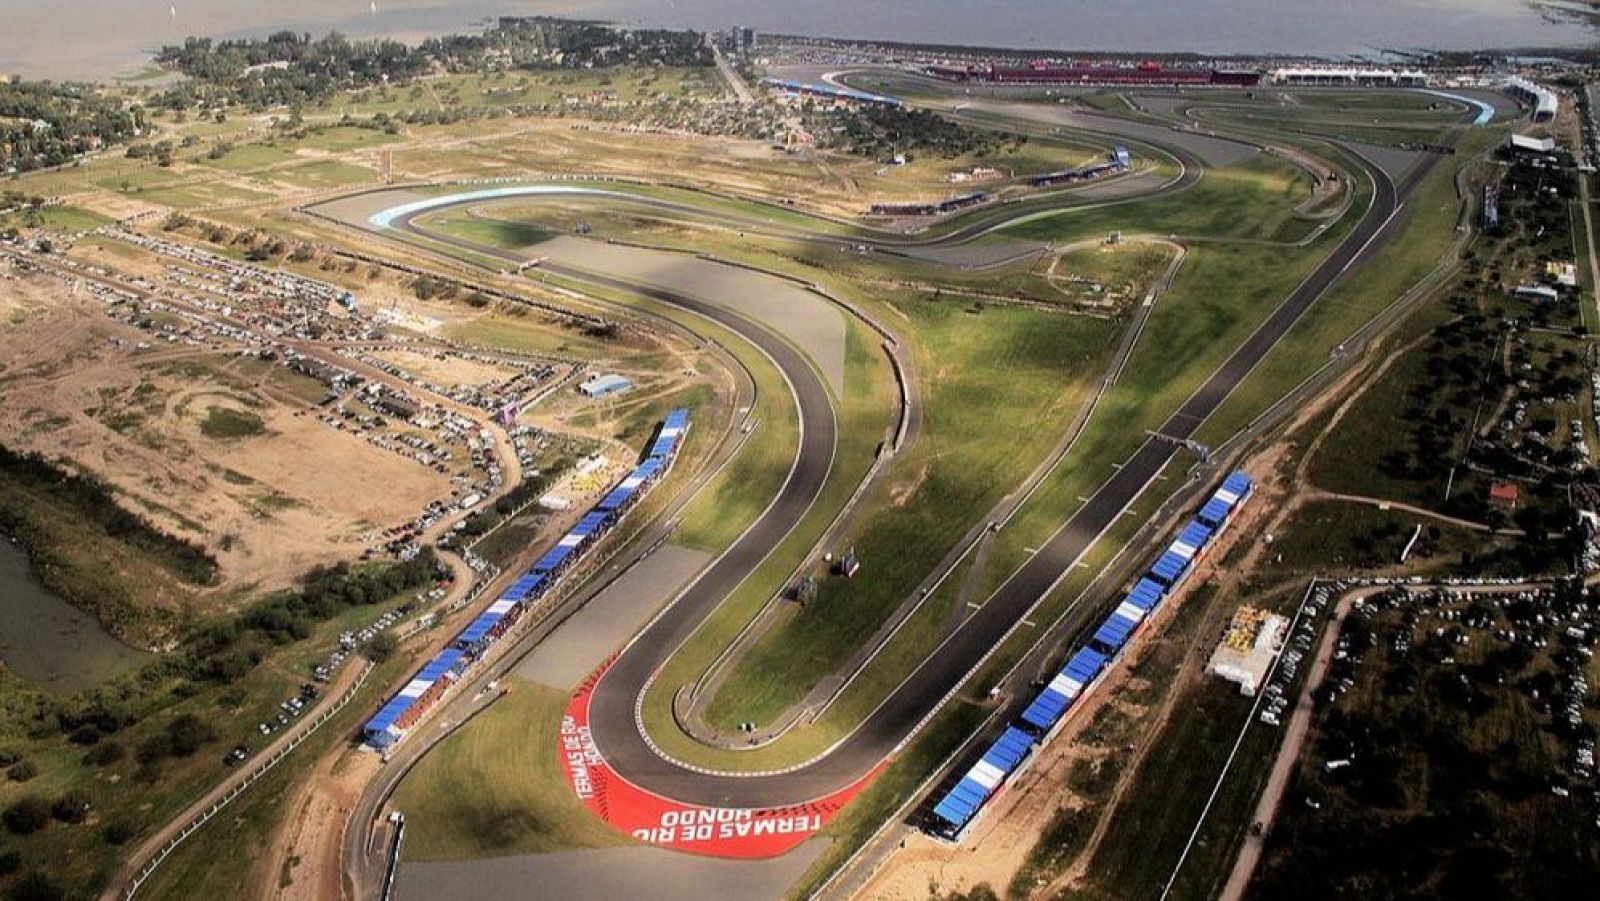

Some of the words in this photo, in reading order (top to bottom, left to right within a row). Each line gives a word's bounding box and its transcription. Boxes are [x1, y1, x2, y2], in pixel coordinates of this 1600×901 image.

[563, 734, 581, 751] DE
[567, 752, 594, 799] TERMAS
[661, 808, 751, 827] HONDO
[719, 813, 822, 840] TERMAS
[681, 825, 713, 841] DE
